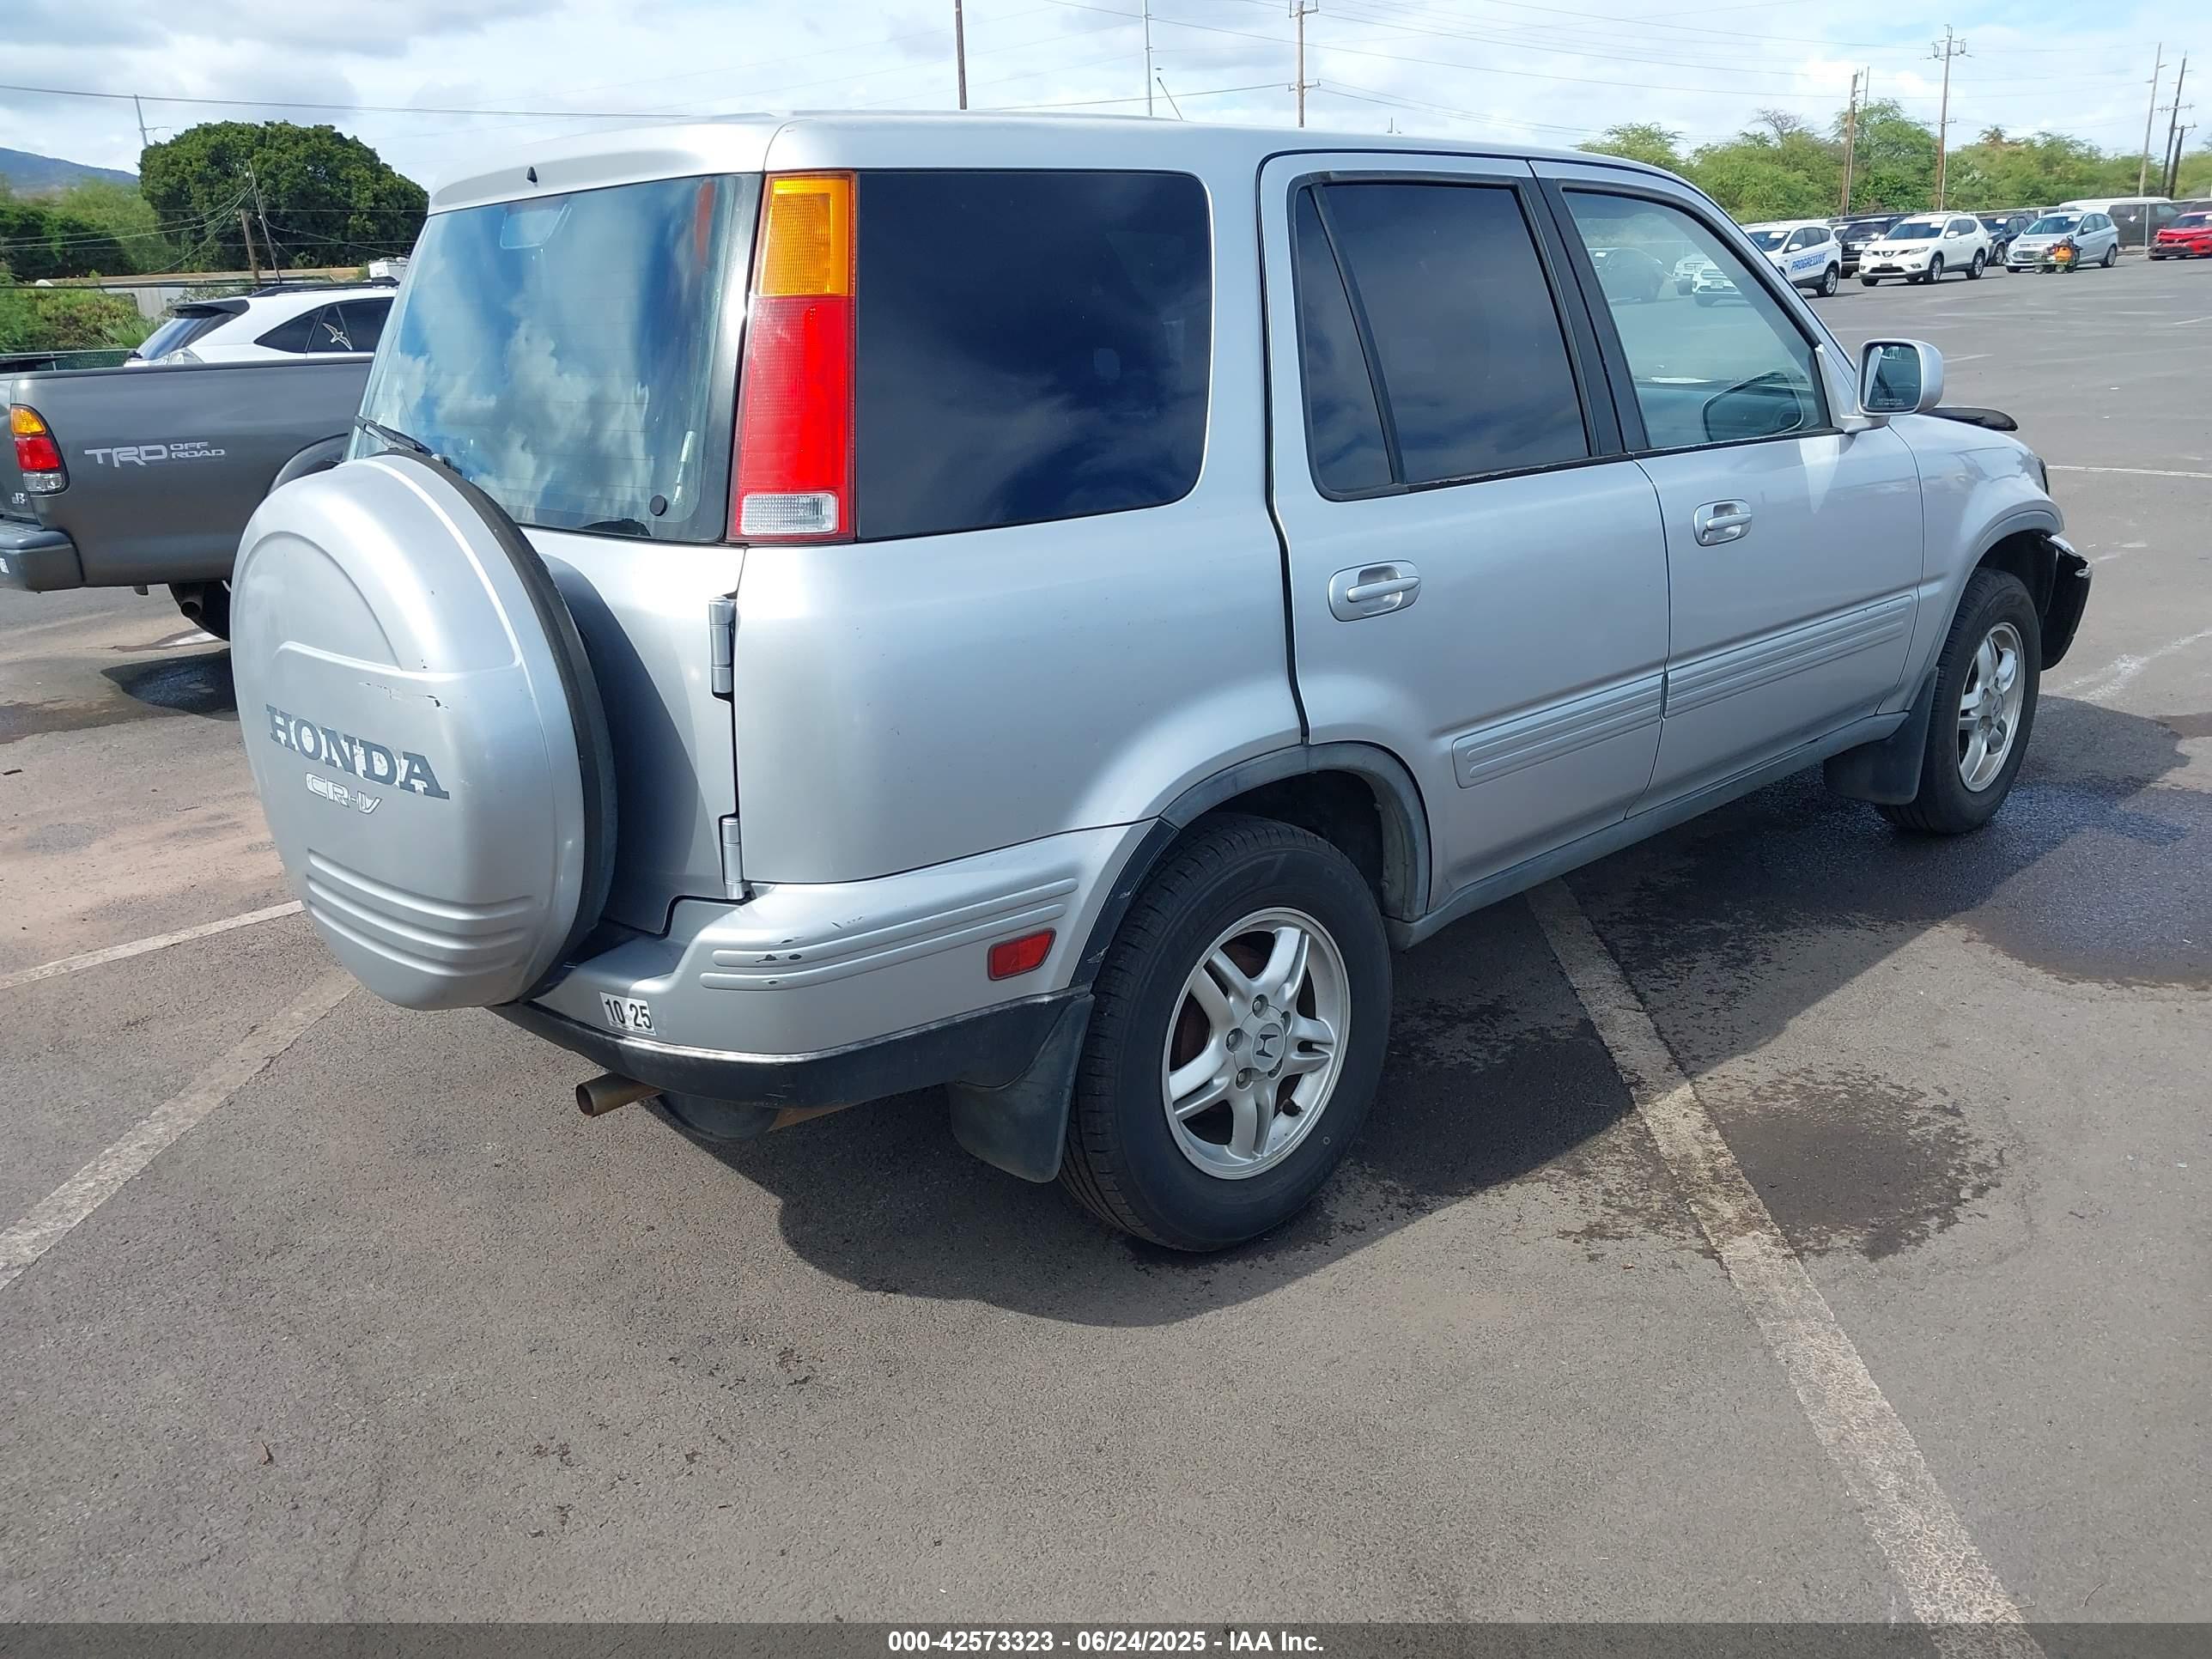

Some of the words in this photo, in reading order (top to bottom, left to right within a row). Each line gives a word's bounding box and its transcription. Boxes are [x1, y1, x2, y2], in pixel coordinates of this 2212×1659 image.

[84, 445, 167, 468] TRD
[170, 441, 210, 451] OFF
[171, 449, 226, 459] ROAD
[265, 703, 451, 800] HONDA
[305, 772, 383, 815] CR-V
[605, 998, 626, 1024] 10
[629, 1003, 653, 1030] 25
